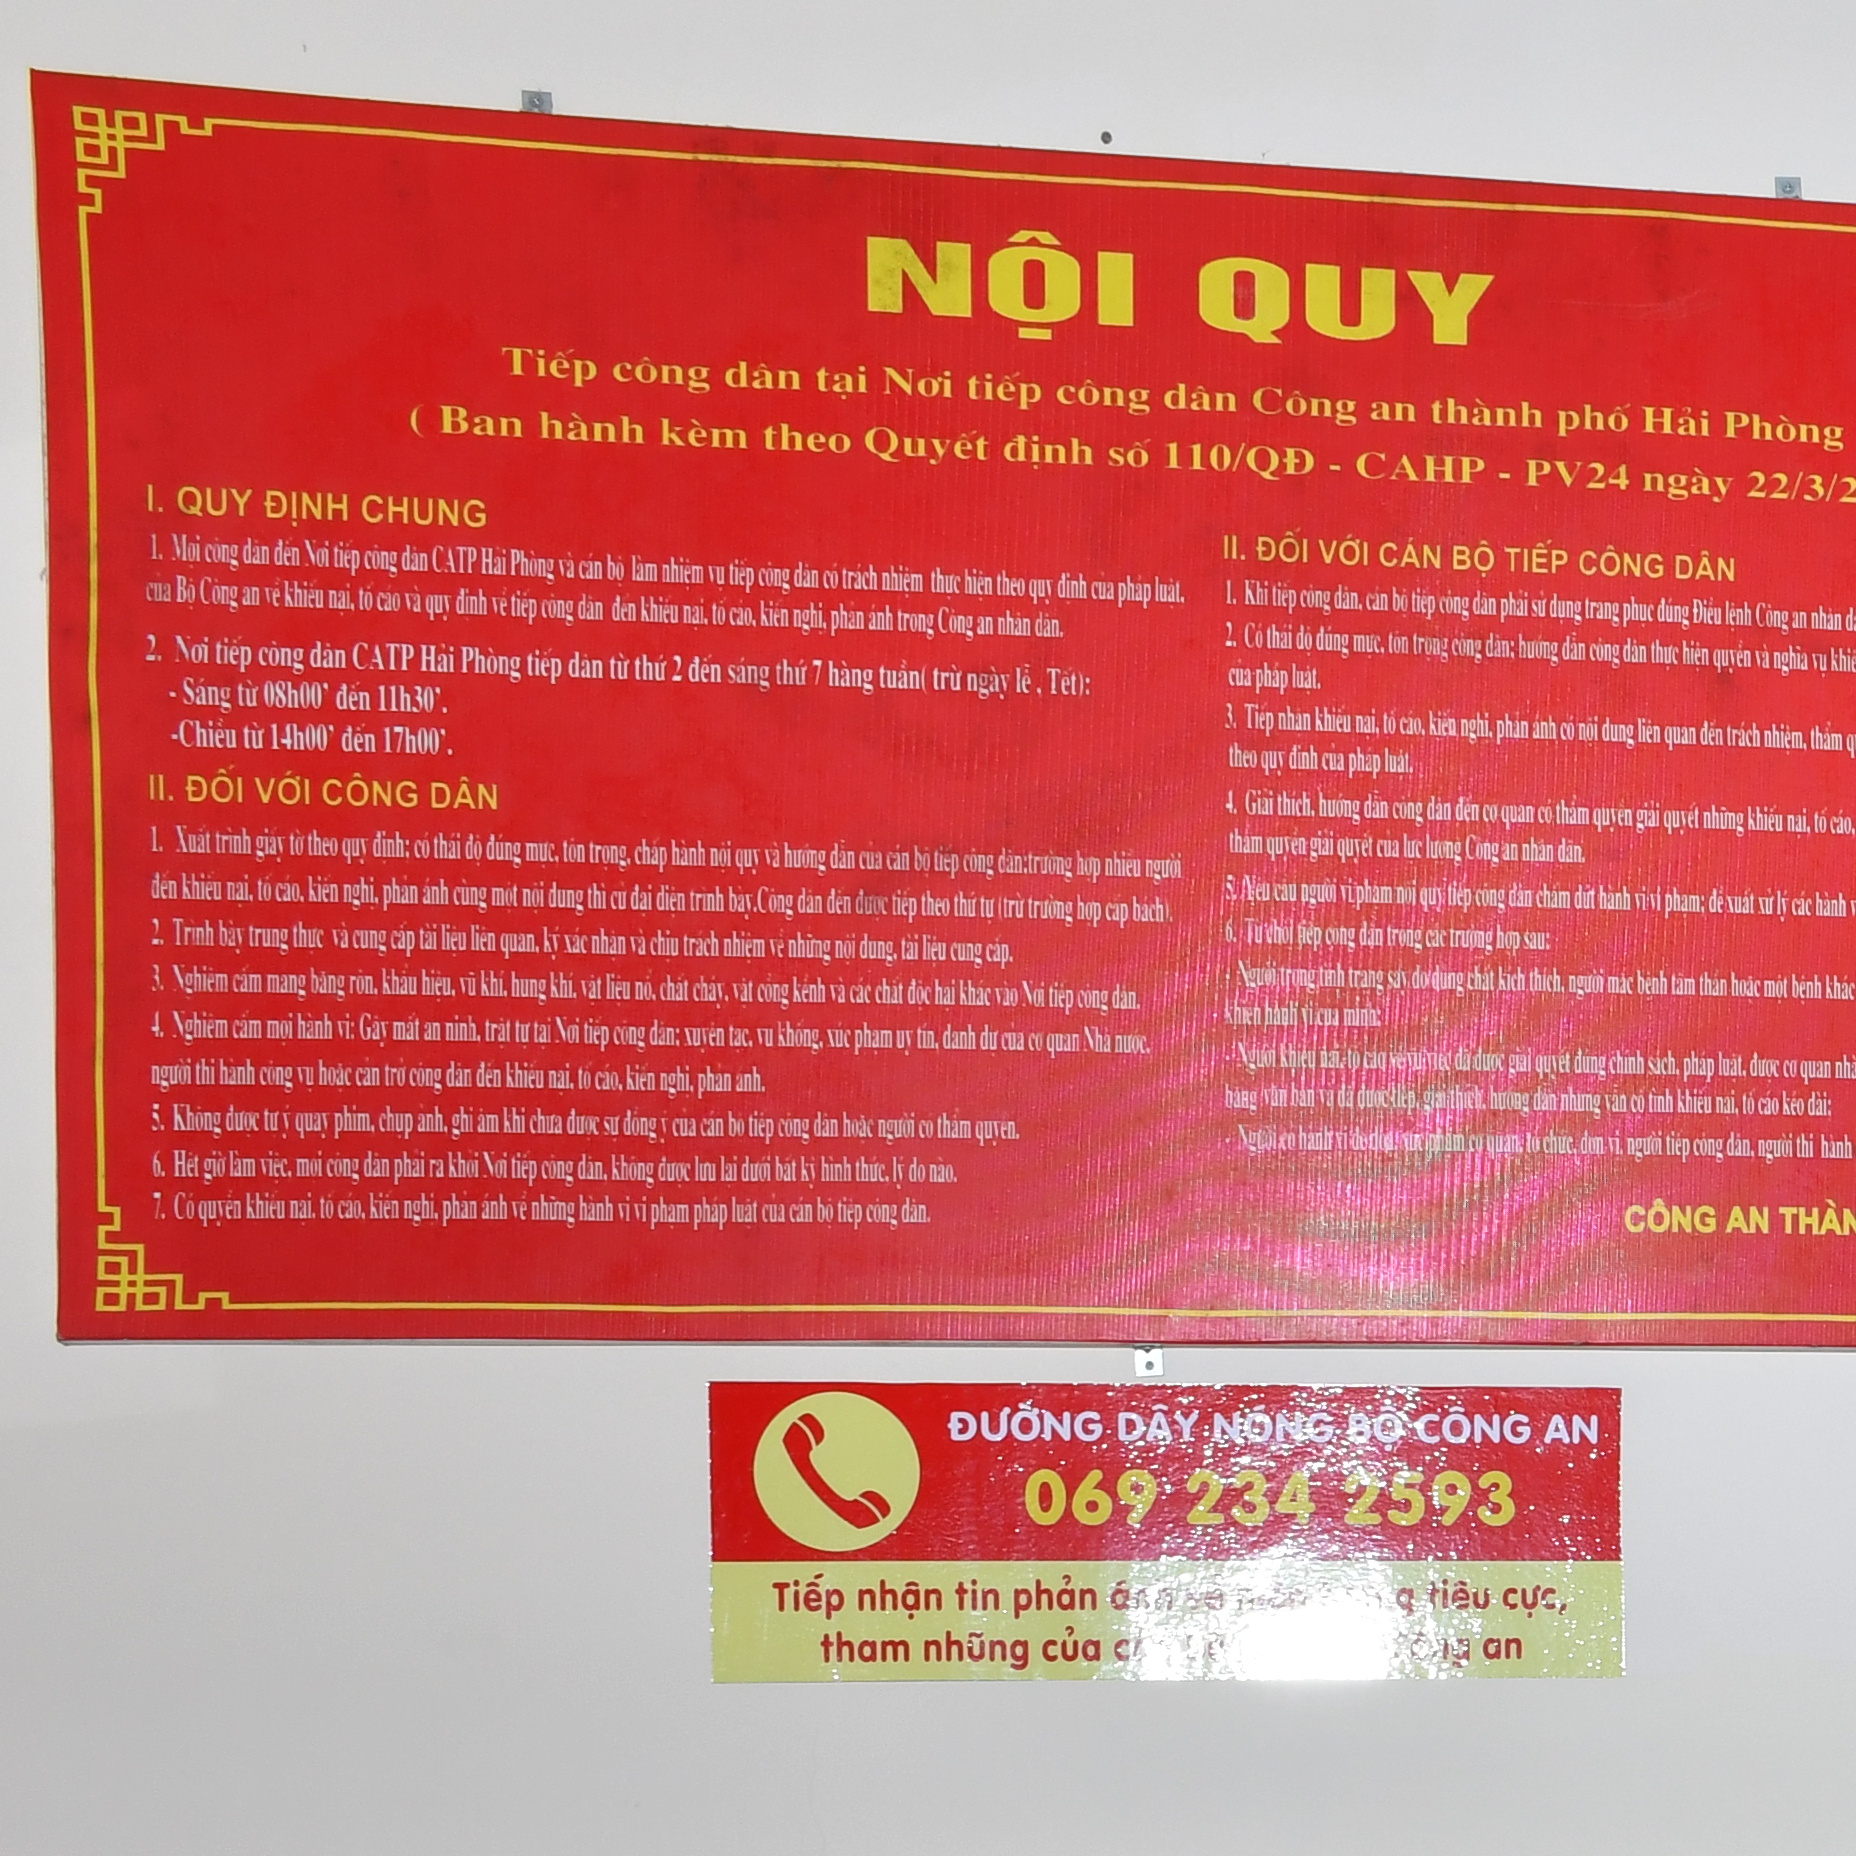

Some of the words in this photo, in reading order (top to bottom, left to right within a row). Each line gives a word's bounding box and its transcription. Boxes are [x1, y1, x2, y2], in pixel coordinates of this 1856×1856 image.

[866, 232, 1134, 341] NỘI
[1198, 256, 1495, 346] QUY
[501, 347, 598, 388] Tiếp
[612, 356, 711, 394] công
[724, 360, 801, 390] dân
[816, 365, 868, 400] tại
[883, 366, 953, 399] Nơi
[967, 372, 1042, 411] tiếp
[1056, 378, 1151, 416] công
[1163, 382, 1237, 413] dân
[1252, 386, 1358, 427] Công
[1369, 401, 1417, 423] an
[1431, 397, 1543, 428] thành
[1557, 403, 1631, 438] phố
[1641, 406, 1710, 437] Hải
[1724, 411, 1844, 453] Phòng
[440, 405, 523, 438] Ban
[539, 411, 645, 444] hành
[660, 417, 748, 449] kèm
[763, 422, 852, 454] theo
[864, 426, 989, 465] Quyết
[1003, 434, 1094, 470] định
[1108, 441, 1149, 468] số
[1166, 441, 1315, 481] 110/QĐ
[1355, 451, 1486, 484] CAHP
[1526, 459, 1630, 491] PV24
[1643, 467, 1734, 503] ngày
[147, 483, 164, 513] I.
[177, 485, 253, 517] QUY
[263, 489, 349, 528] ĐỊNH
[361, 494, 487, 528] CHUNG
[1223, 534, 1246, 561] II.
[1255, 530, 1308, 563] ĐỐI
[1318, 533, 1369, 566] VỚI
[1378, 536, 1442, 570] CÁN
[1452, 539, 1495, 578] BỘ
[1503, 539, 1569, 574] TIẾP
[1578, 544, 1665, 579] CÔNG
[1674, 549, 1735, 582] DÂN
[149, 773, 174, 802] II.
[184, 769, 243, 804] ĐỐI
[254, 771, 310, 806] VỚI
[321, 773, 419, 808] CÔNG
[430, 775, 498, 811] DÂN
[1622, 1195, 1717, 1235] CÔNG
[1724, 1205, 1770, 1235] AN
[947, 1400, 1103, 1442] ĐƯỜNG
[1117, 1403, 1198, 1442] DÂY
[1212, 1404, 1335, 1444] NÓNG
[1350, 1406, 1401, 1450] BỘ
[1415, 1406, 1532, 1444] CÔNG
[1543, 1413, 1599, 1445] AN
[1024, 1468, 1157, 1526] 069
[1187, 1470, 1315, 1525] 234
[1345, 1470, 1516, 1526] 2593
[771, 1572, 845, 1620] Tiếp
[857, 1578, 943, 1621] nhận
[954, 1578, 1000, 1612] tin
[1013, 1574, 1098, 1620] phản
[1426, 1578, 1491, 1611] tiêu
[1502, 1584, 1568, 1619] cực,
[819, 1630, 911, 1664] tham
[923, 1629, 1030, 1669] nhũng
[1041, 1625, 1102, 1663] của
[1482, 1637, 1523, 1661] an
